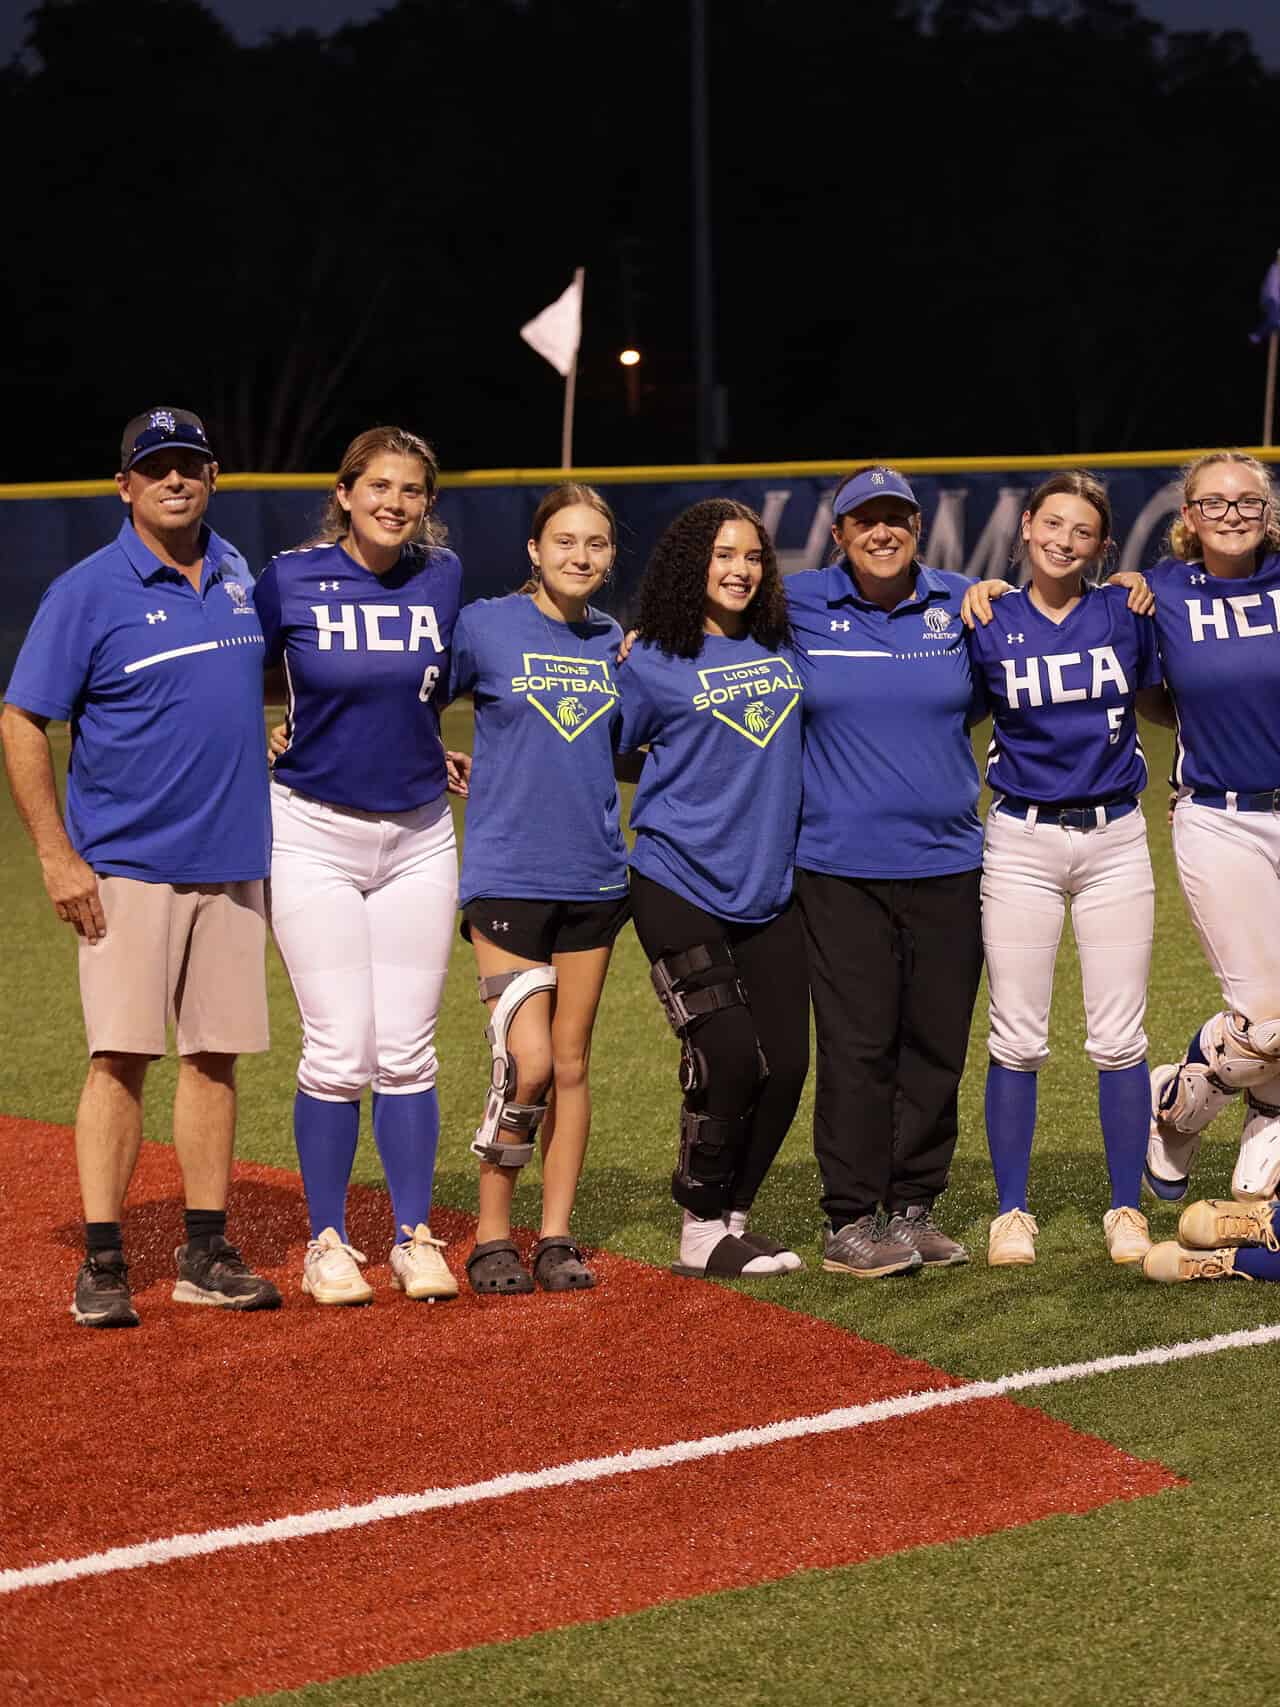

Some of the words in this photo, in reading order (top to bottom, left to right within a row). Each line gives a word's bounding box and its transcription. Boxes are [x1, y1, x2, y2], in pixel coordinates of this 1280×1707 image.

[309, 604, 445, 652] HCA
[418, 665, 440, 703] 6
[545, 663, 590, 675] LIONS
[722, 665, 771, 681] LIONS
[1000, 645, 1129, 709] HCA
[1106, 706, 1126, 745] 5
